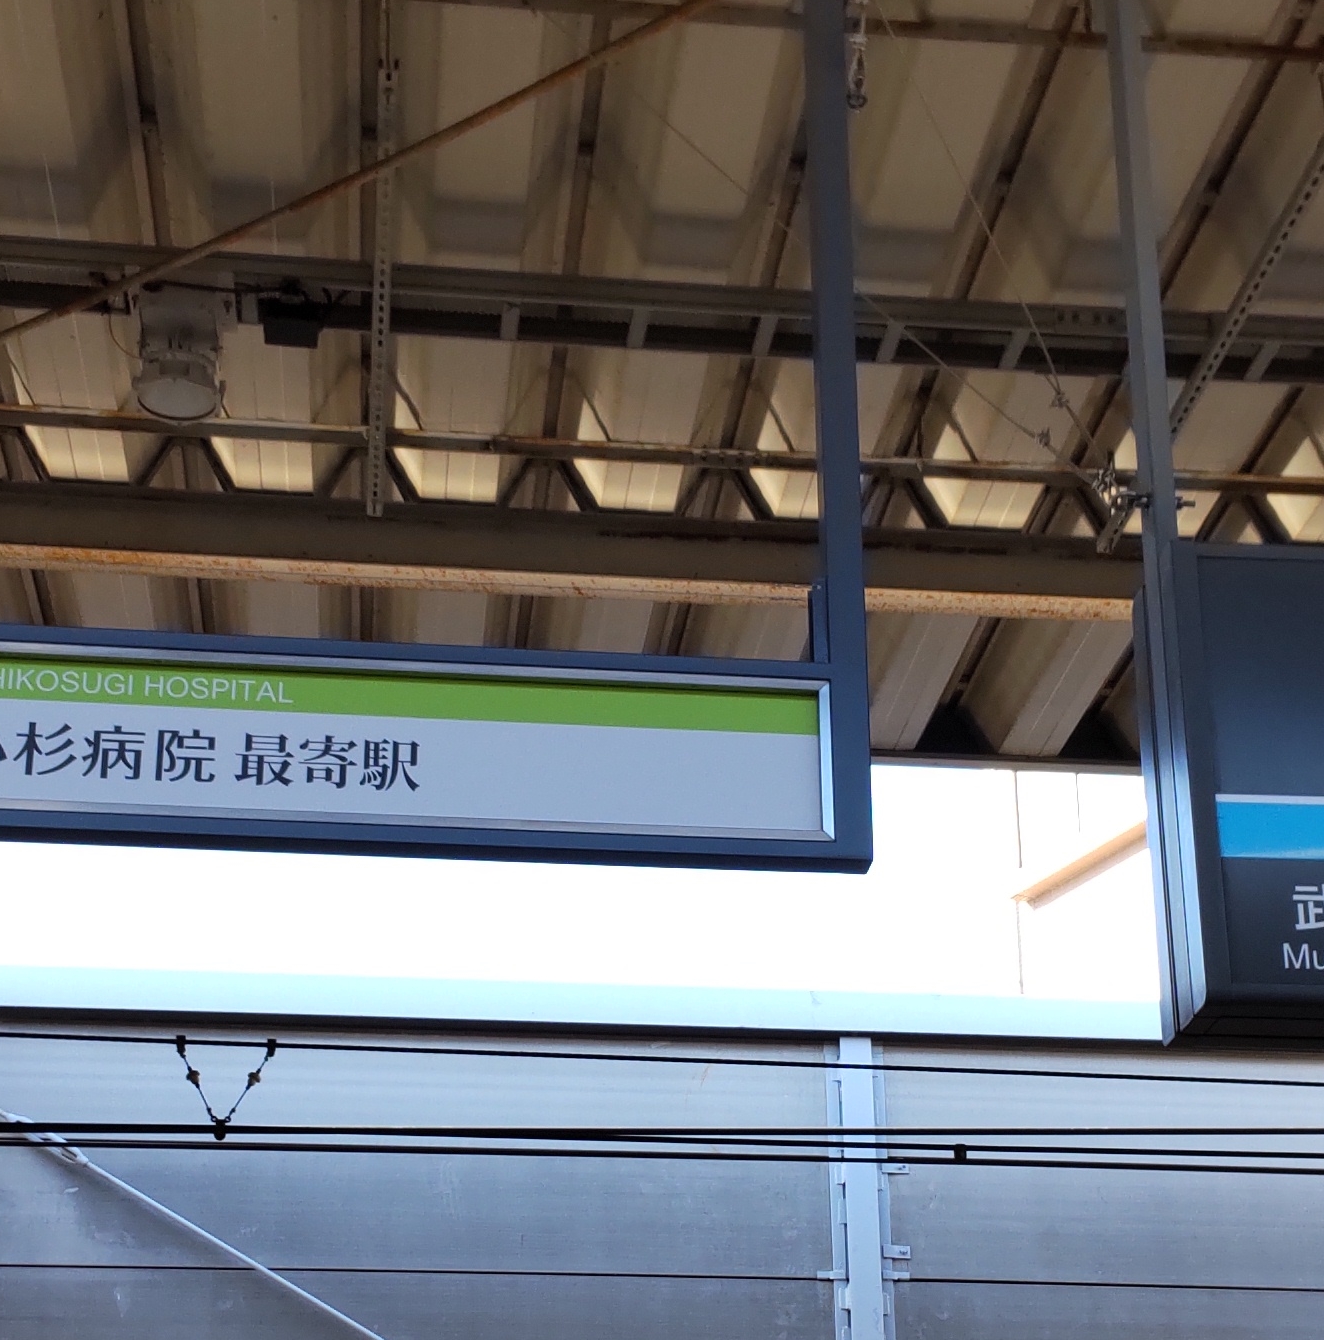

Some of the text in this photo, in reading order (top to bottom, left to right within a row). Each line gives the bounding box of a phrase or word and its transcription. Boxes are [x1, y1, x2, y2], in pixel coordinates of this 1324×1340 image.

[144, 679, 294, 704] HOSPITAL
[234, 732, 420, 792] 最寄駅
